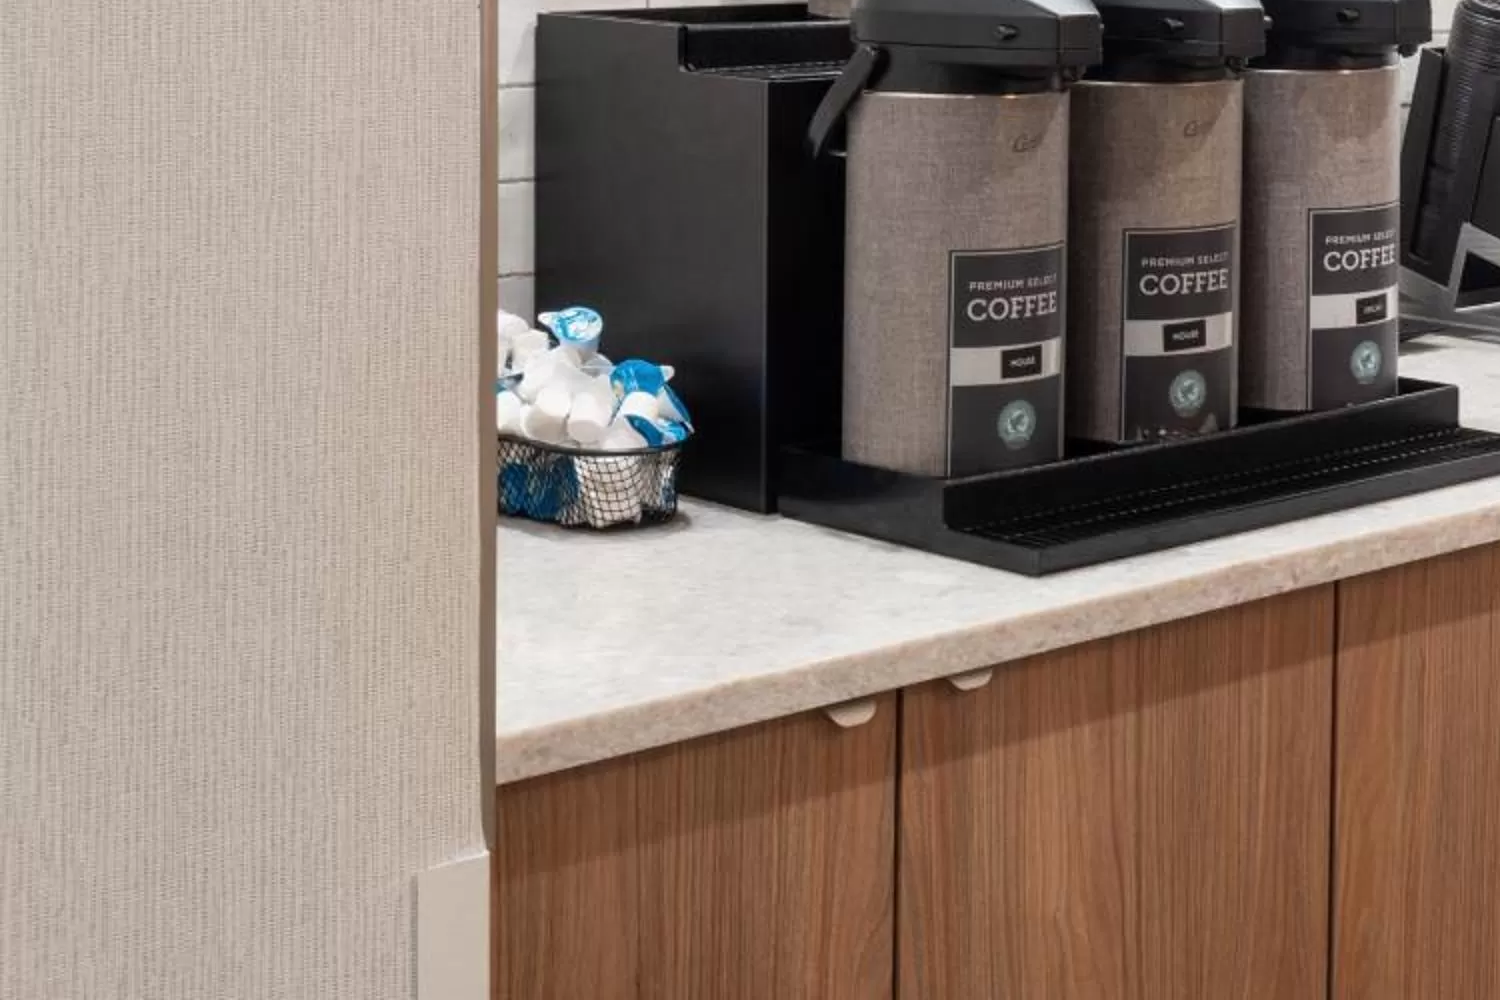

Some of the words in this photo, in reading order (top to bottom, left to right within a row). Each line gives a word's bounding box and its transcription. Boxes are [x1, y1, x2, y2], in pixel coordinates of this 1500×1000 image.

[1325, 233, 1371, 245] PREMIUM
[1141, 257, 1195, 268] PREMIUM
[1323, 244, 1396, 271] COFFEE
[969, 279, 1024, 292] PREMIUM
[1139, 268, 1229, 295] COFFEE
[967, 291, 1057, 321] COFFEE
